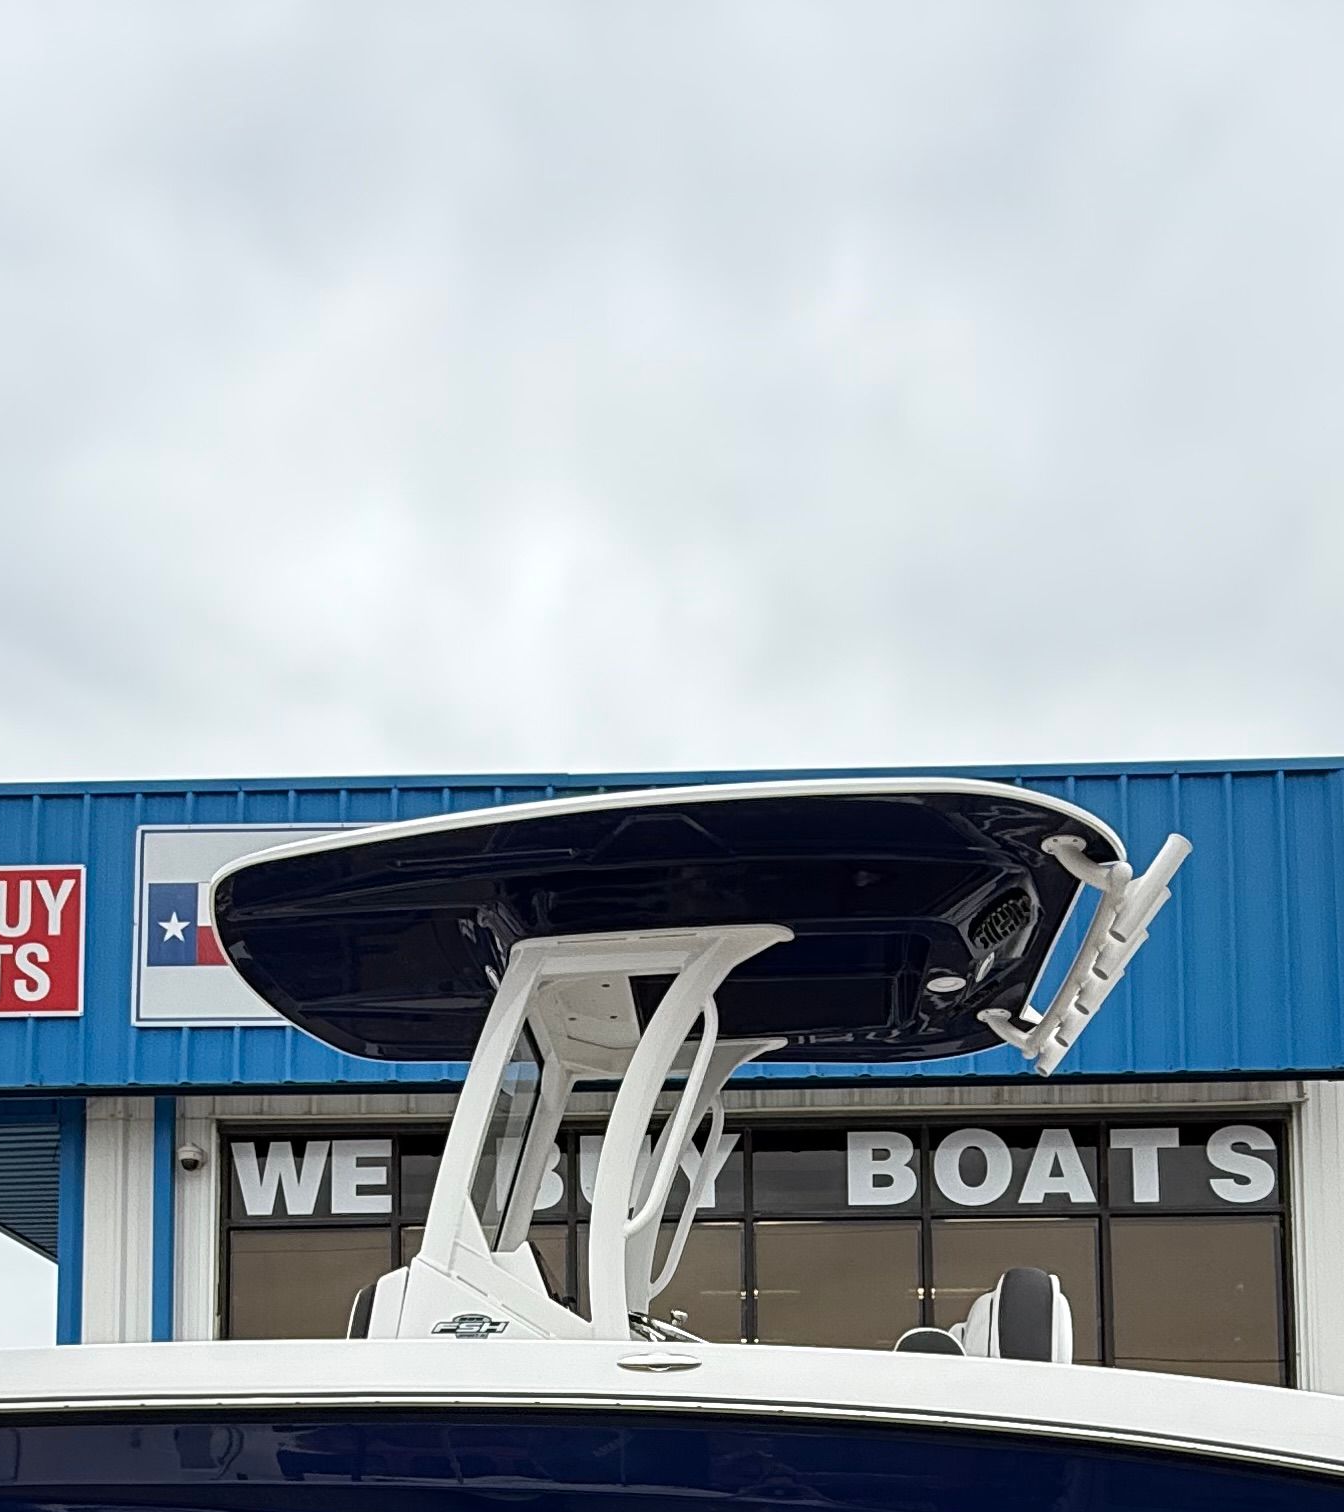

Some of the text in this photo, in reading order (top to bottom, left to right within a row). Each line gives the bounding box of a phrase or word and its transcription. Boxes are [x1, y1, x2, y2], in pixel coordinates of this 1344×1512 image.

[231, 1138, 393, 1216] WE
[846, 1125, 1276, 1207] BOATS
[431, 1321, 509, 1334] FSH
